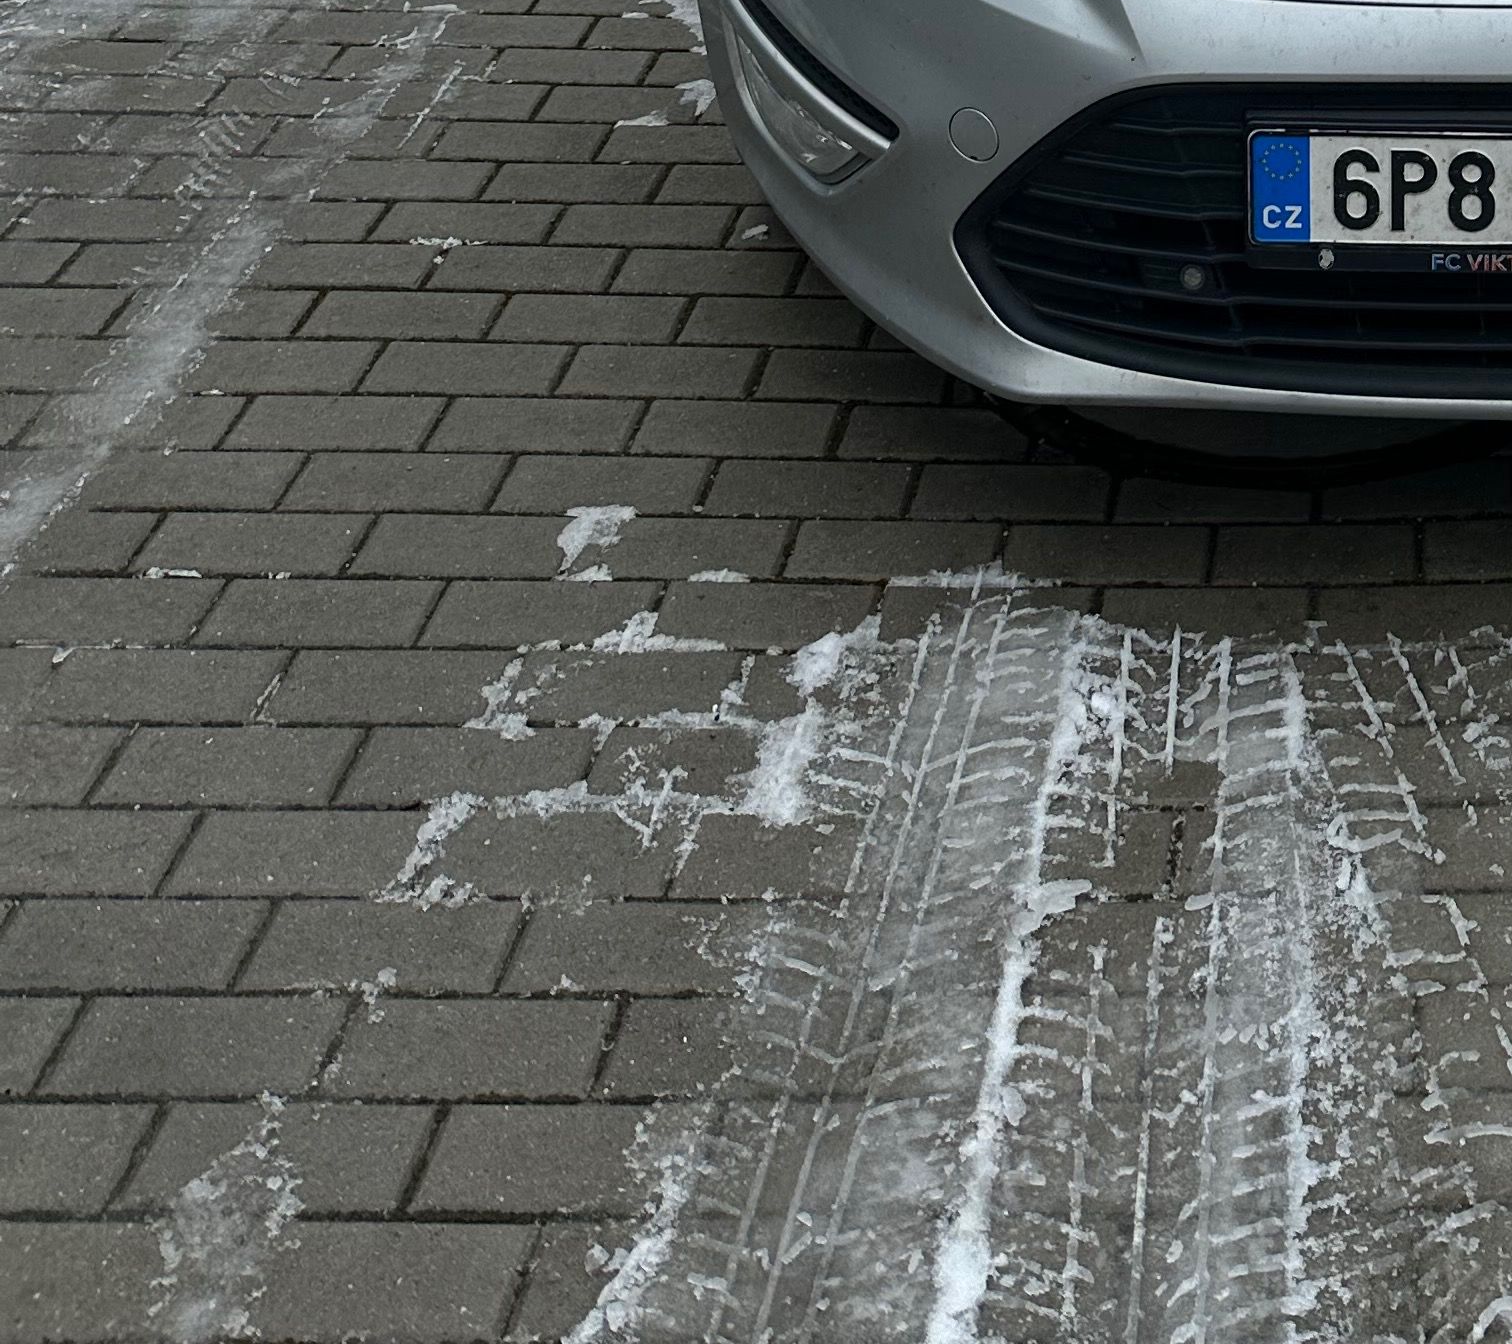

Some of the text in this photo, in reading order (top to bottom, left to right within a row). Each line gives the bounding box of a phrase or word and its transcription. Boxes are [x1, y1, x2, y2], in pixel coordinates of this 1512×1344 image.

[1332, 148, 1497, 233] 6P8
[1262, 204, 1303, 229] CZ
[1431, 253, 1462, 272] FC
